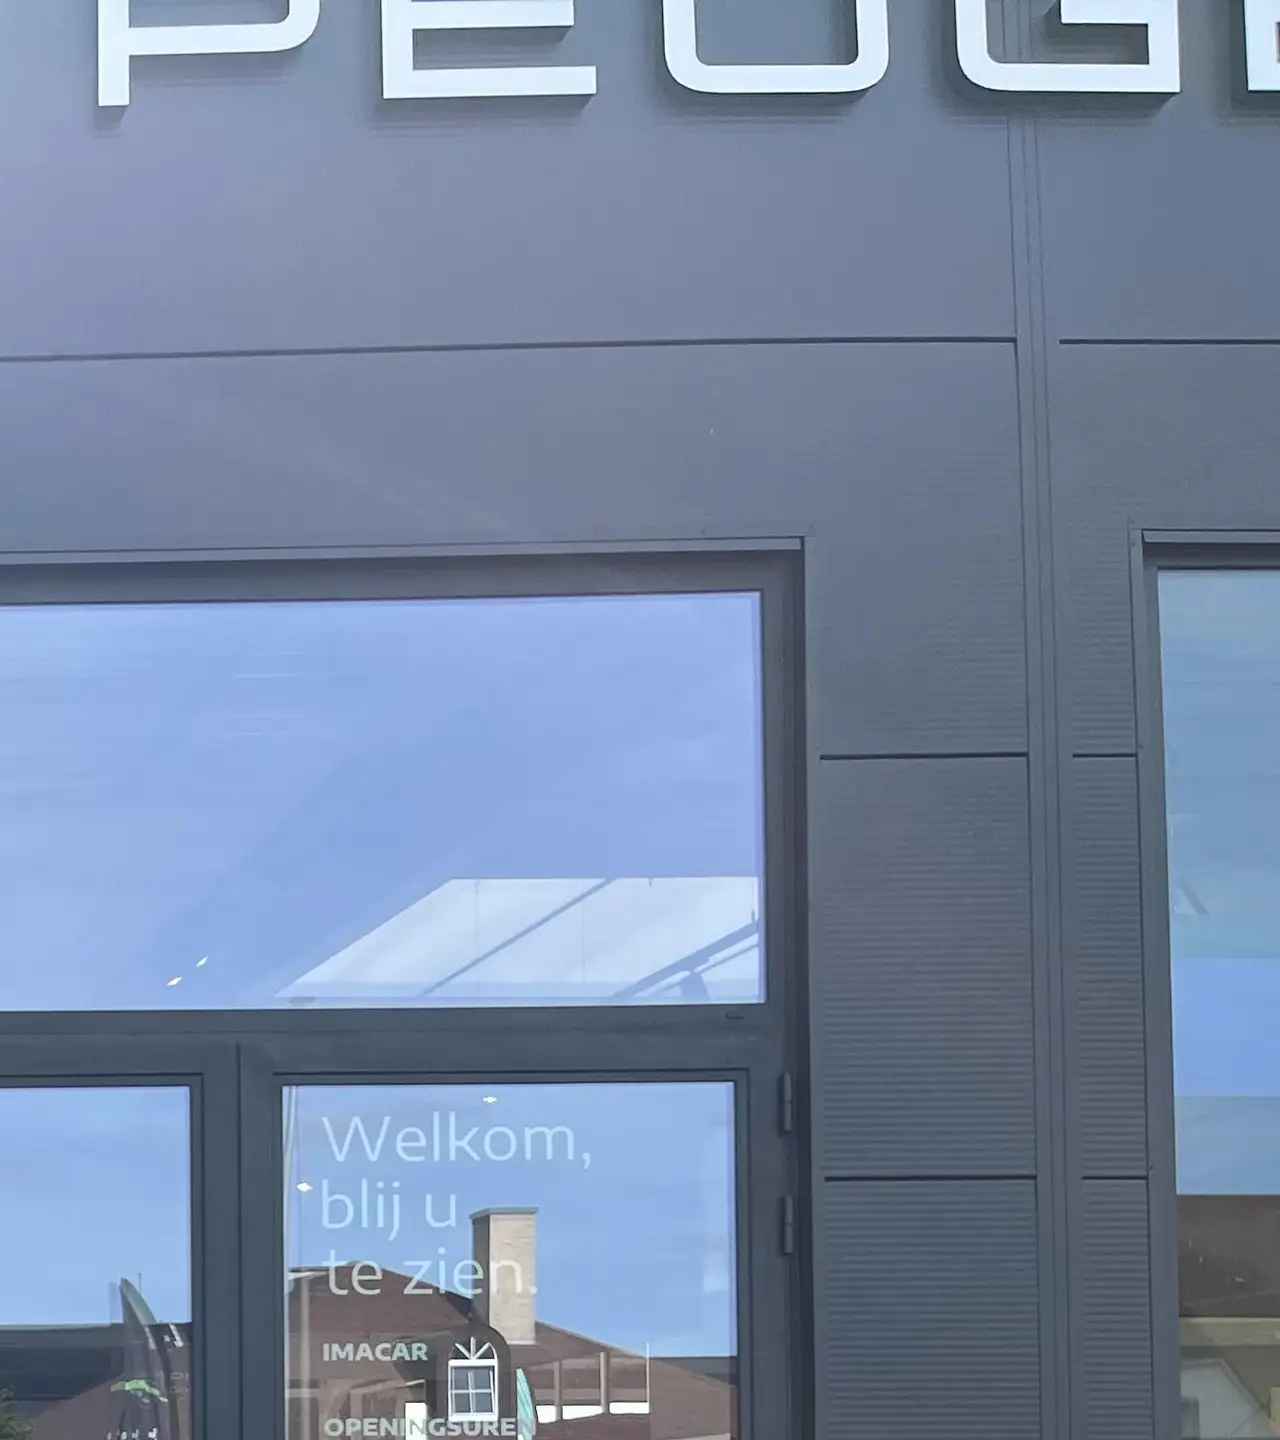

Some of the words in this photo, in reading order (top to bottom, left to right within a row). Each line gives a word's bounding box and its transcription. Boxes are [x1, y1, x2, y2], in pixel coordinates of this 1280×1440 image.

[97, 0, 1280, 105] PEUG
[321, 1111, 592, 1169] Welkom,
[321, 1178, 400, 1241] blij
[425, 1193, 457, 1228] u
[321, 1249, 383, 1295] te
[403, 1247, 539, 1295] zien.
[323, 1342, 429, 1361] IMACAR
[324, 1417, 536, 1437] OPENINGSUREN
